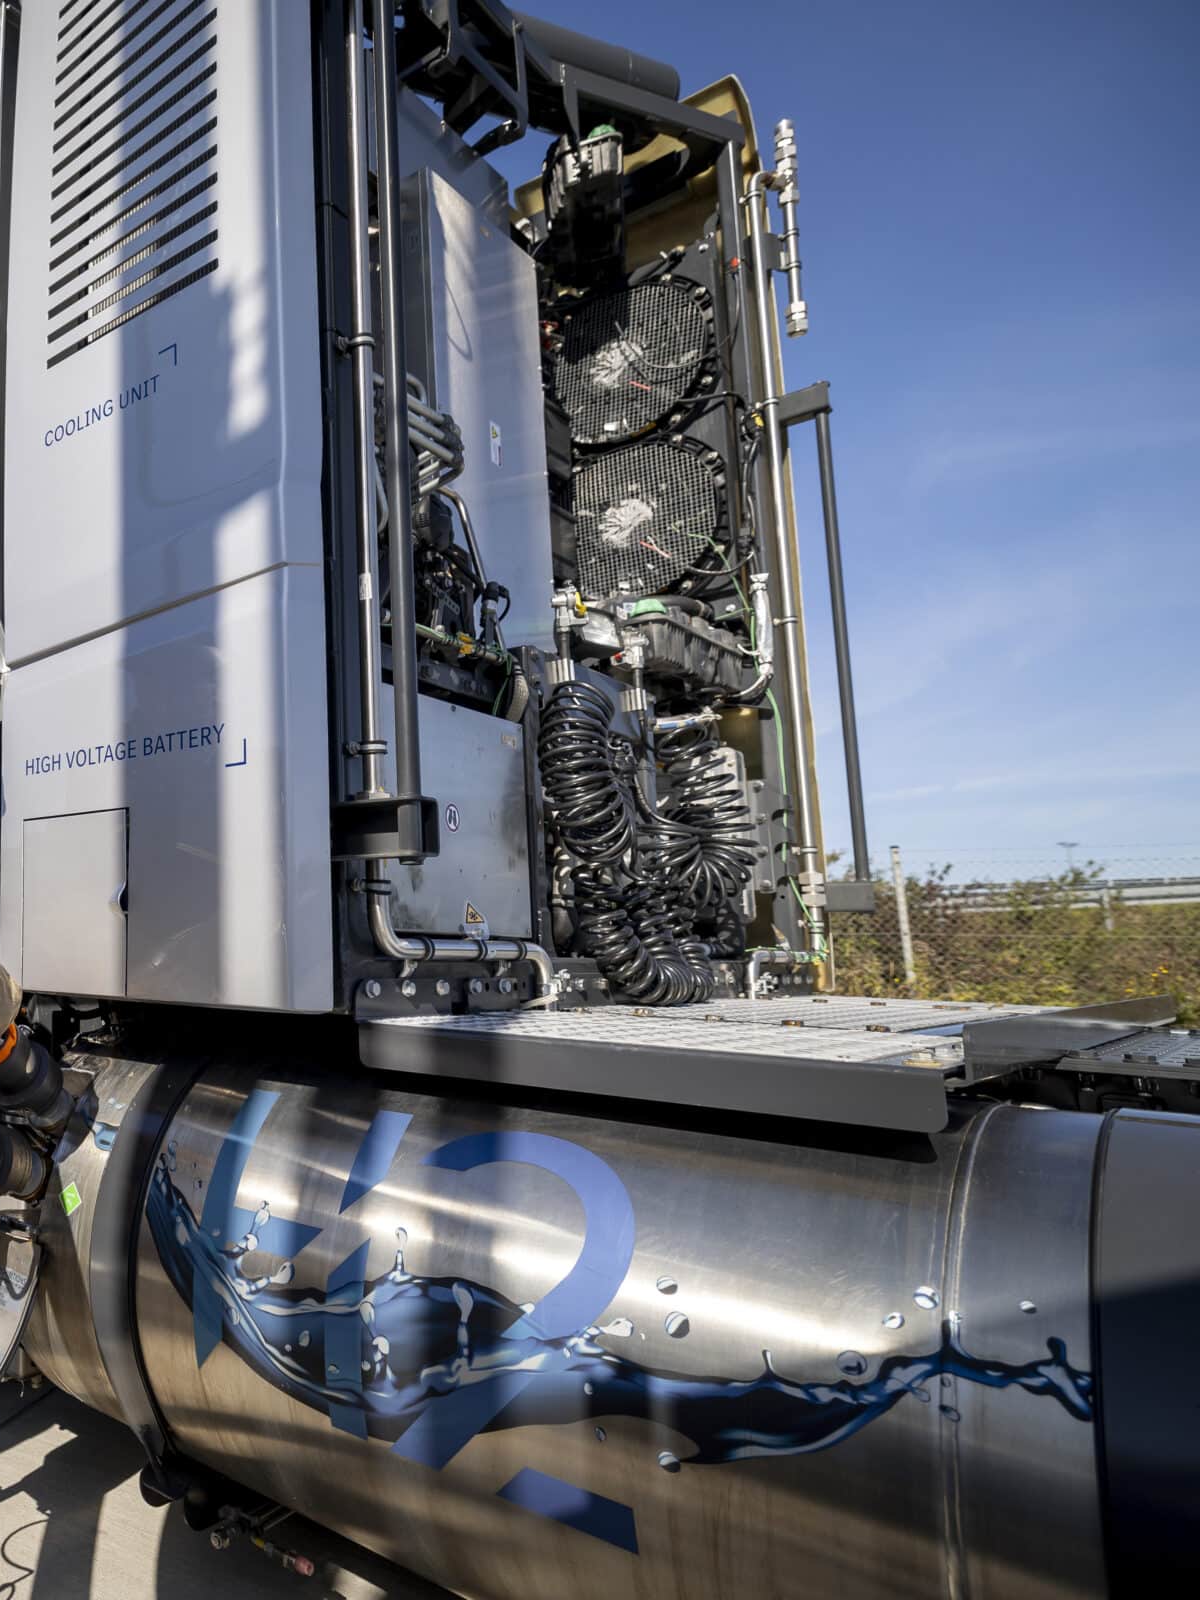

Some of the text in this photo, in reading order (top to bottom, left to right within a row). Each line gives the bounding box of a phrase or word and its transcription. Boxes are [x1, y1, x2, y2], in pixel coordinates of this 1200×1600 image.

[44, 374, 161, 447] COOLING UNIT
[25, 723, 225, 776] HIGH VOLTAGE BATTERY
